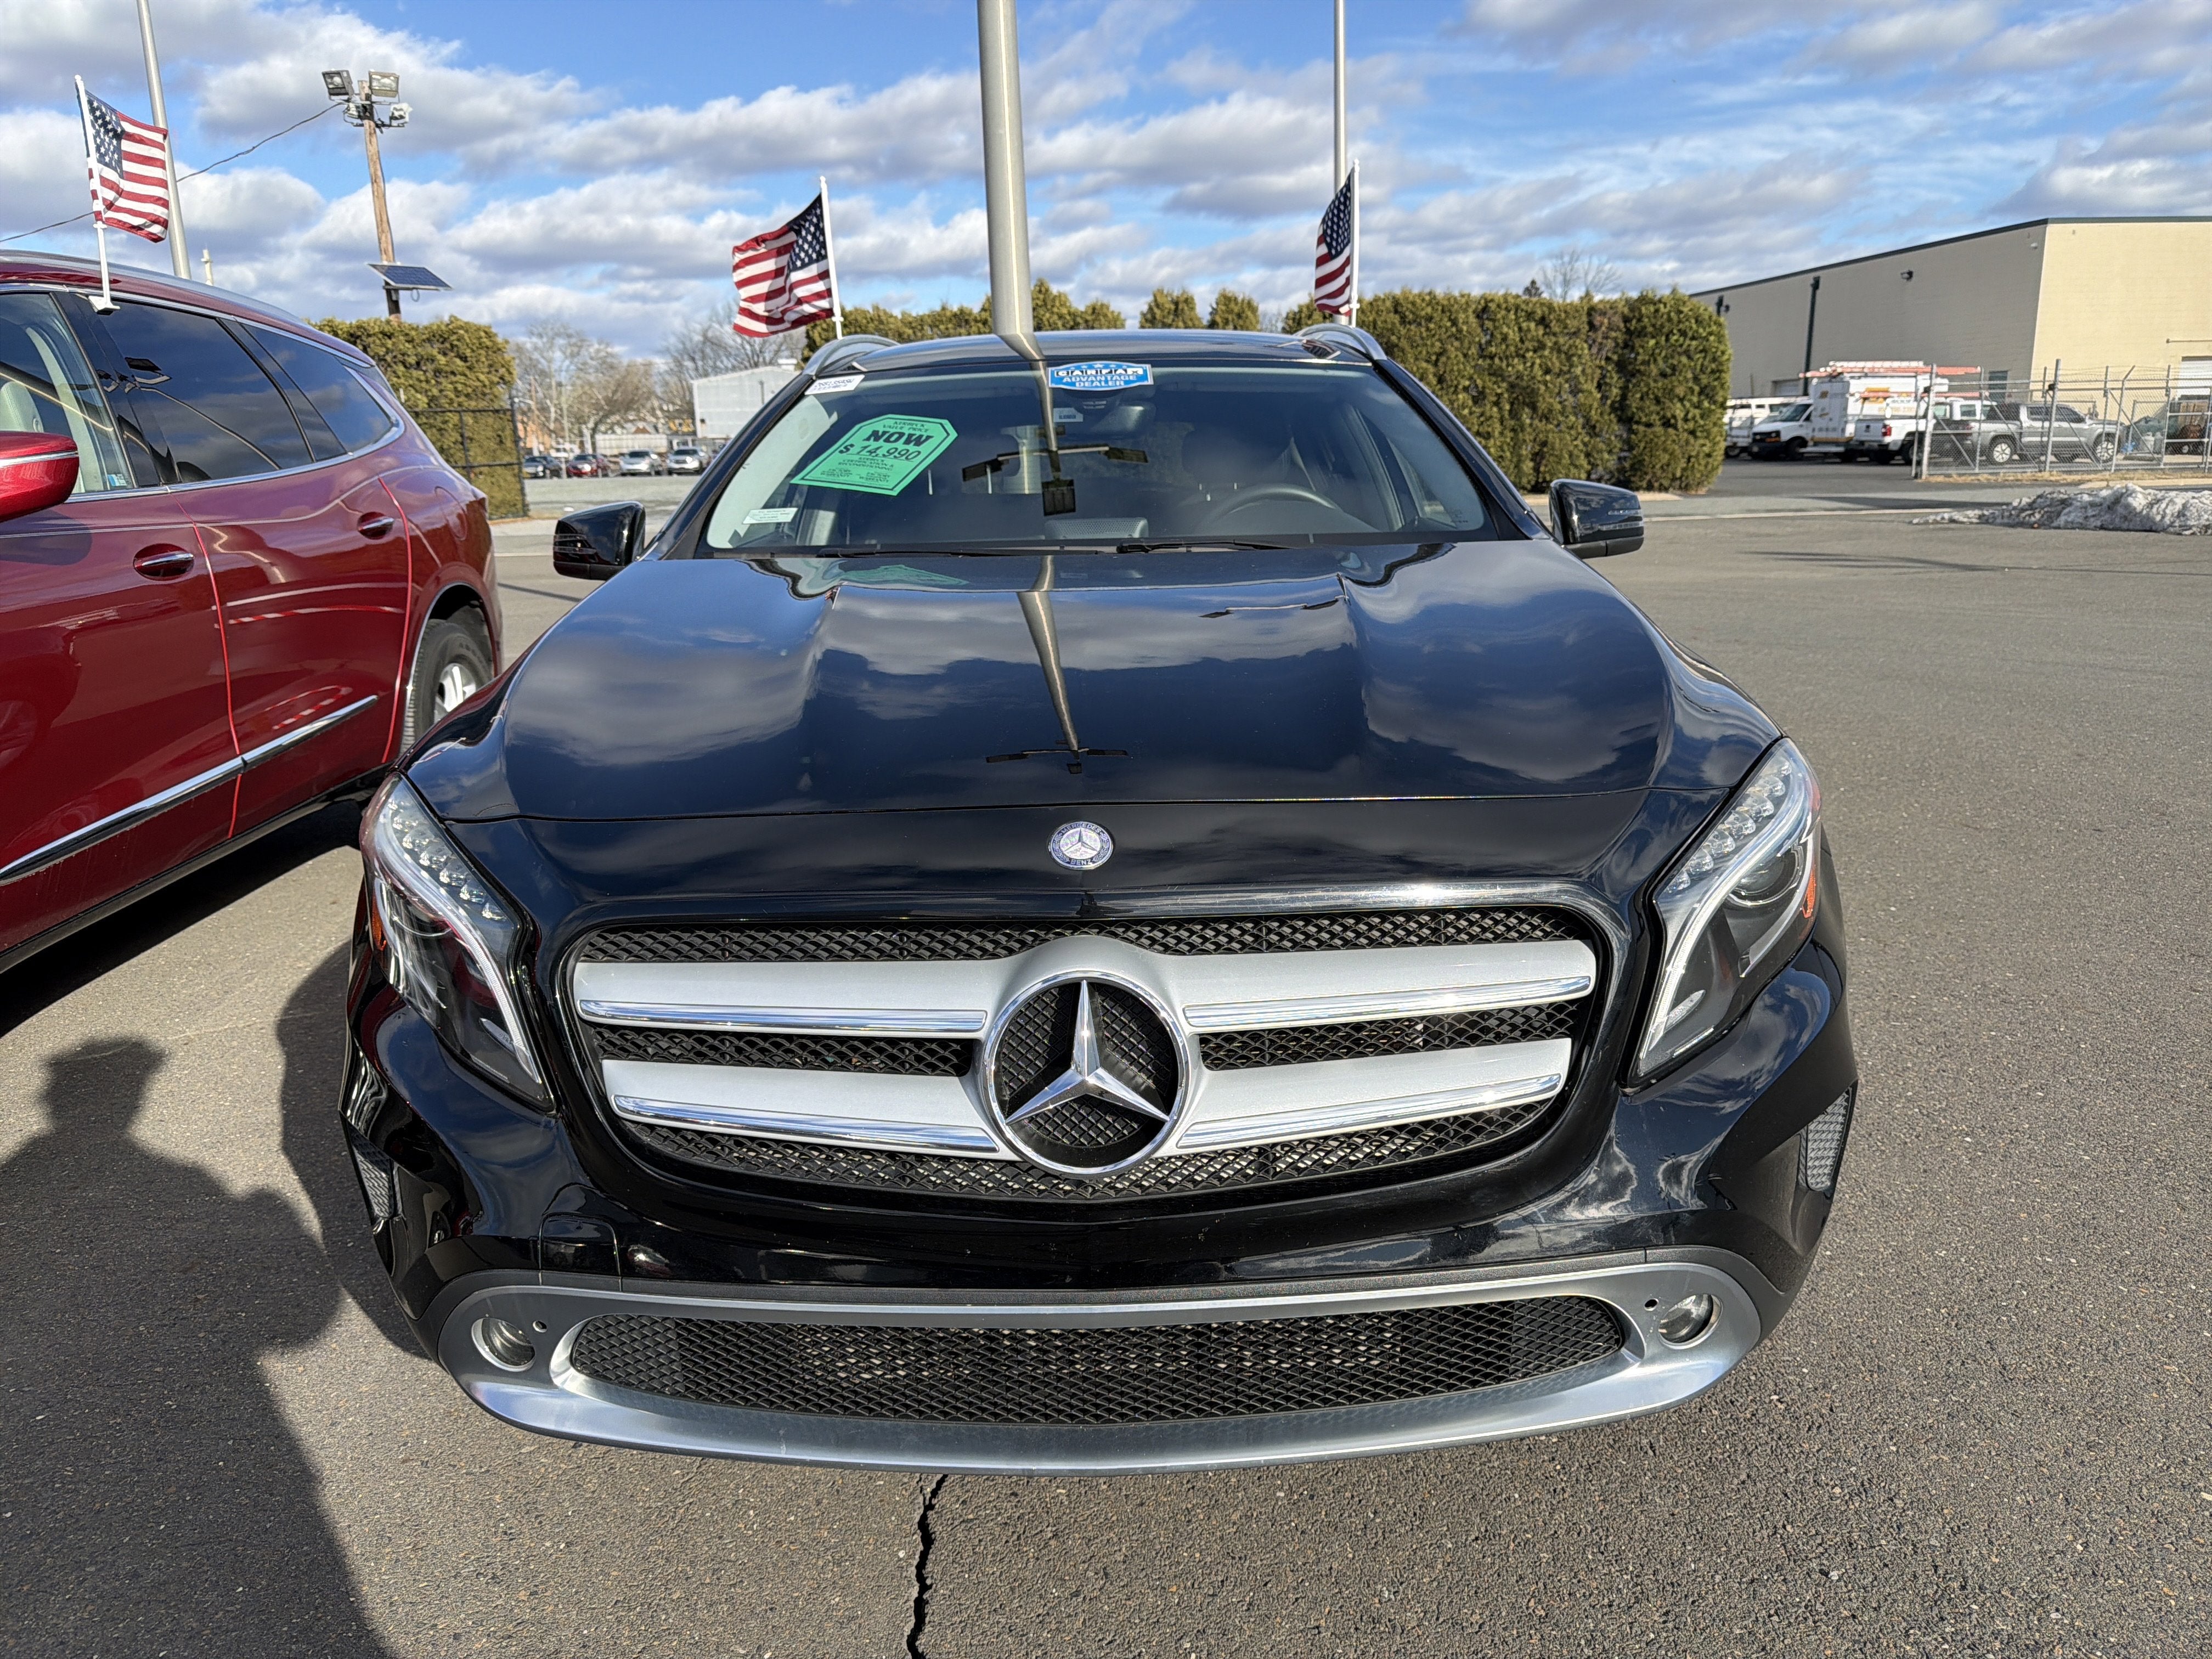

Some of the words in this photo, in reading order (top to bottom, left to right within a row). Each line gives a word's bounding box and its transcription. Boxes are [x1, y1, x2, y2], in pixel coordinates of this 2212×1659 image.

[1056, 368, 1143, 377] CARFAX
[862, 430, 934, 447] NOW
[1061, 822, 1102, 833] MERCEDES
